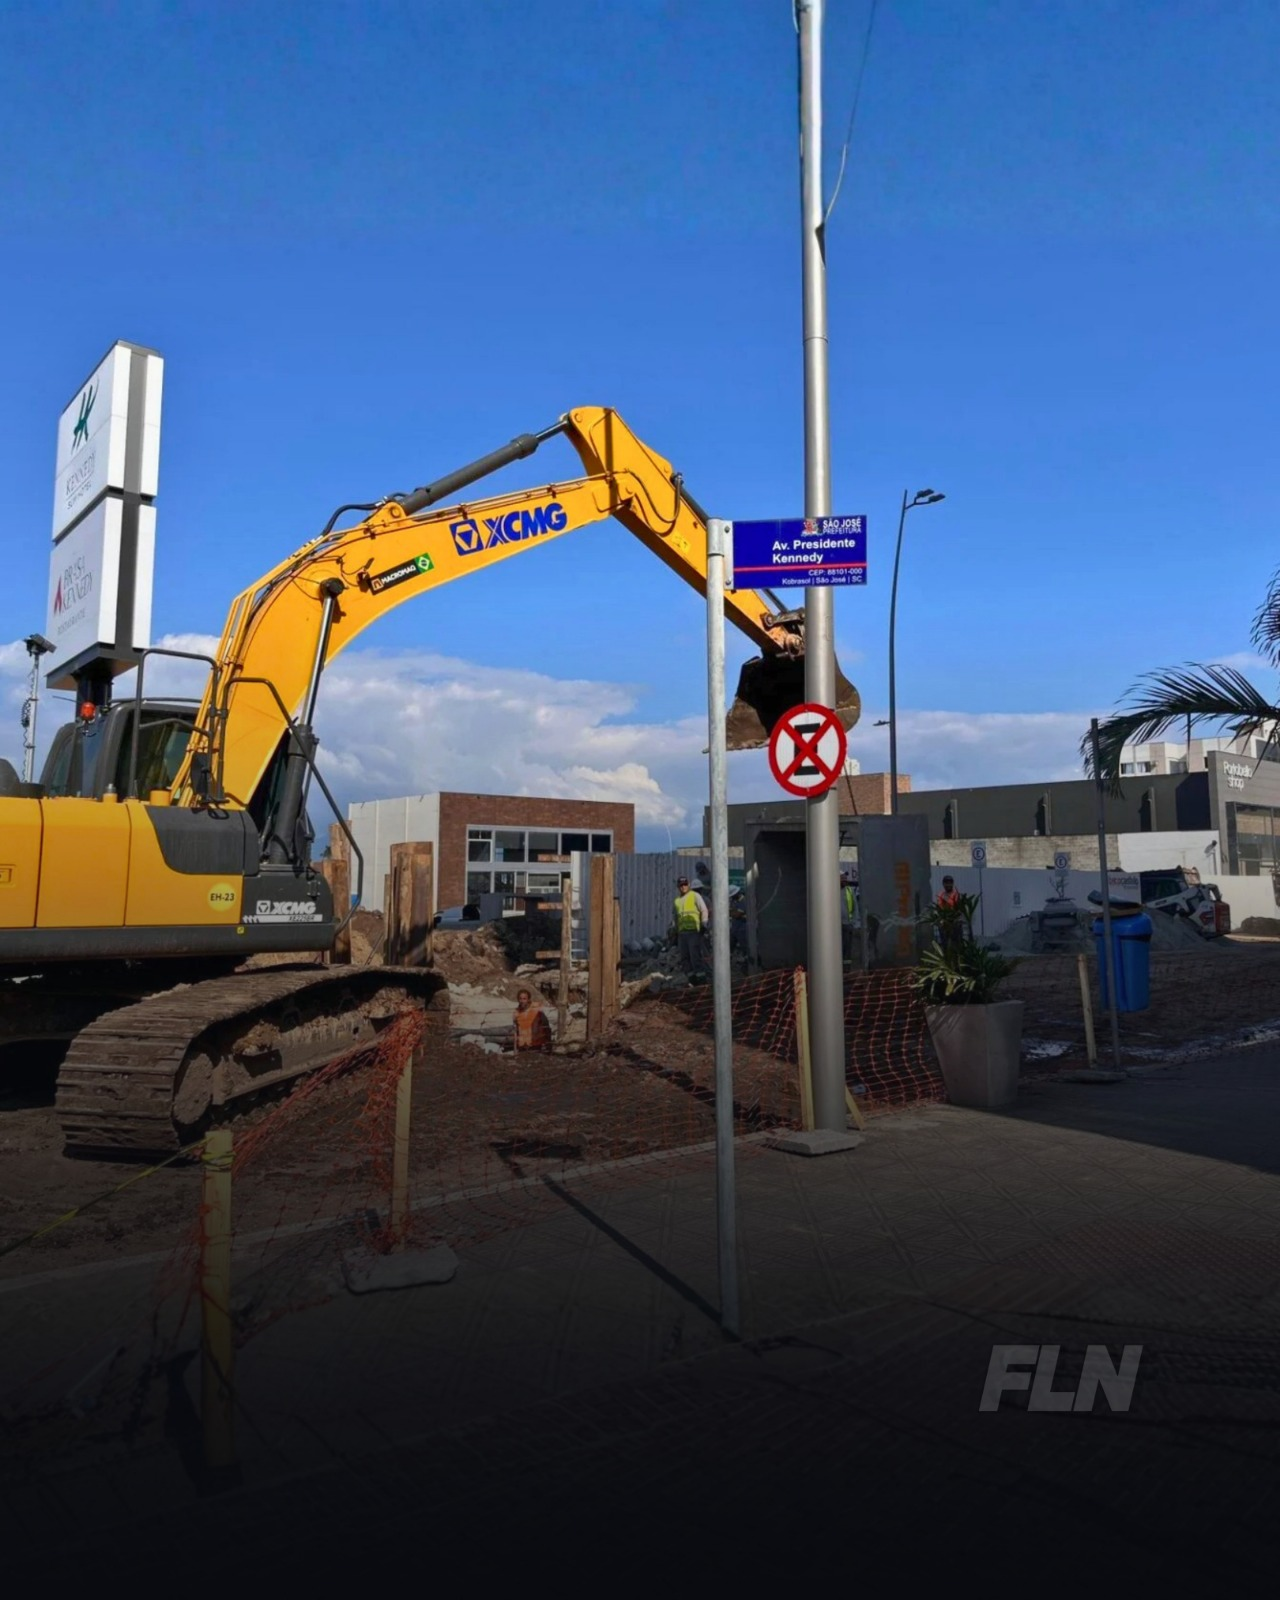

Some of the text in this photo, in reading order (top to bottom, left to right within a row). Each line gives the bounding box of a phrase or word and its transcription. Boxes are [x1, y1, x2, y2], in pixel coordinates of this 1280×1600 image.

[483, 503, 567, 549] XCMG
[823, 518, 861, 529] SÃO JOSÉ
[823, 527, 861, 535] PREFEITURA
[773, 539, 856, 551] Av. Presidente
[773, 553, 823, 564] Kennedy
[808, 569, 826, 577] CEP:
[782, 577, 811, 586] Kobrasol
[816, 577, 830, 585] São
[831, 575, 846, 584] José
[851, 575, 863, 583] SC
[210, 893, 235, 902] EH-23
[270, 901, 317, 915] XCMG
